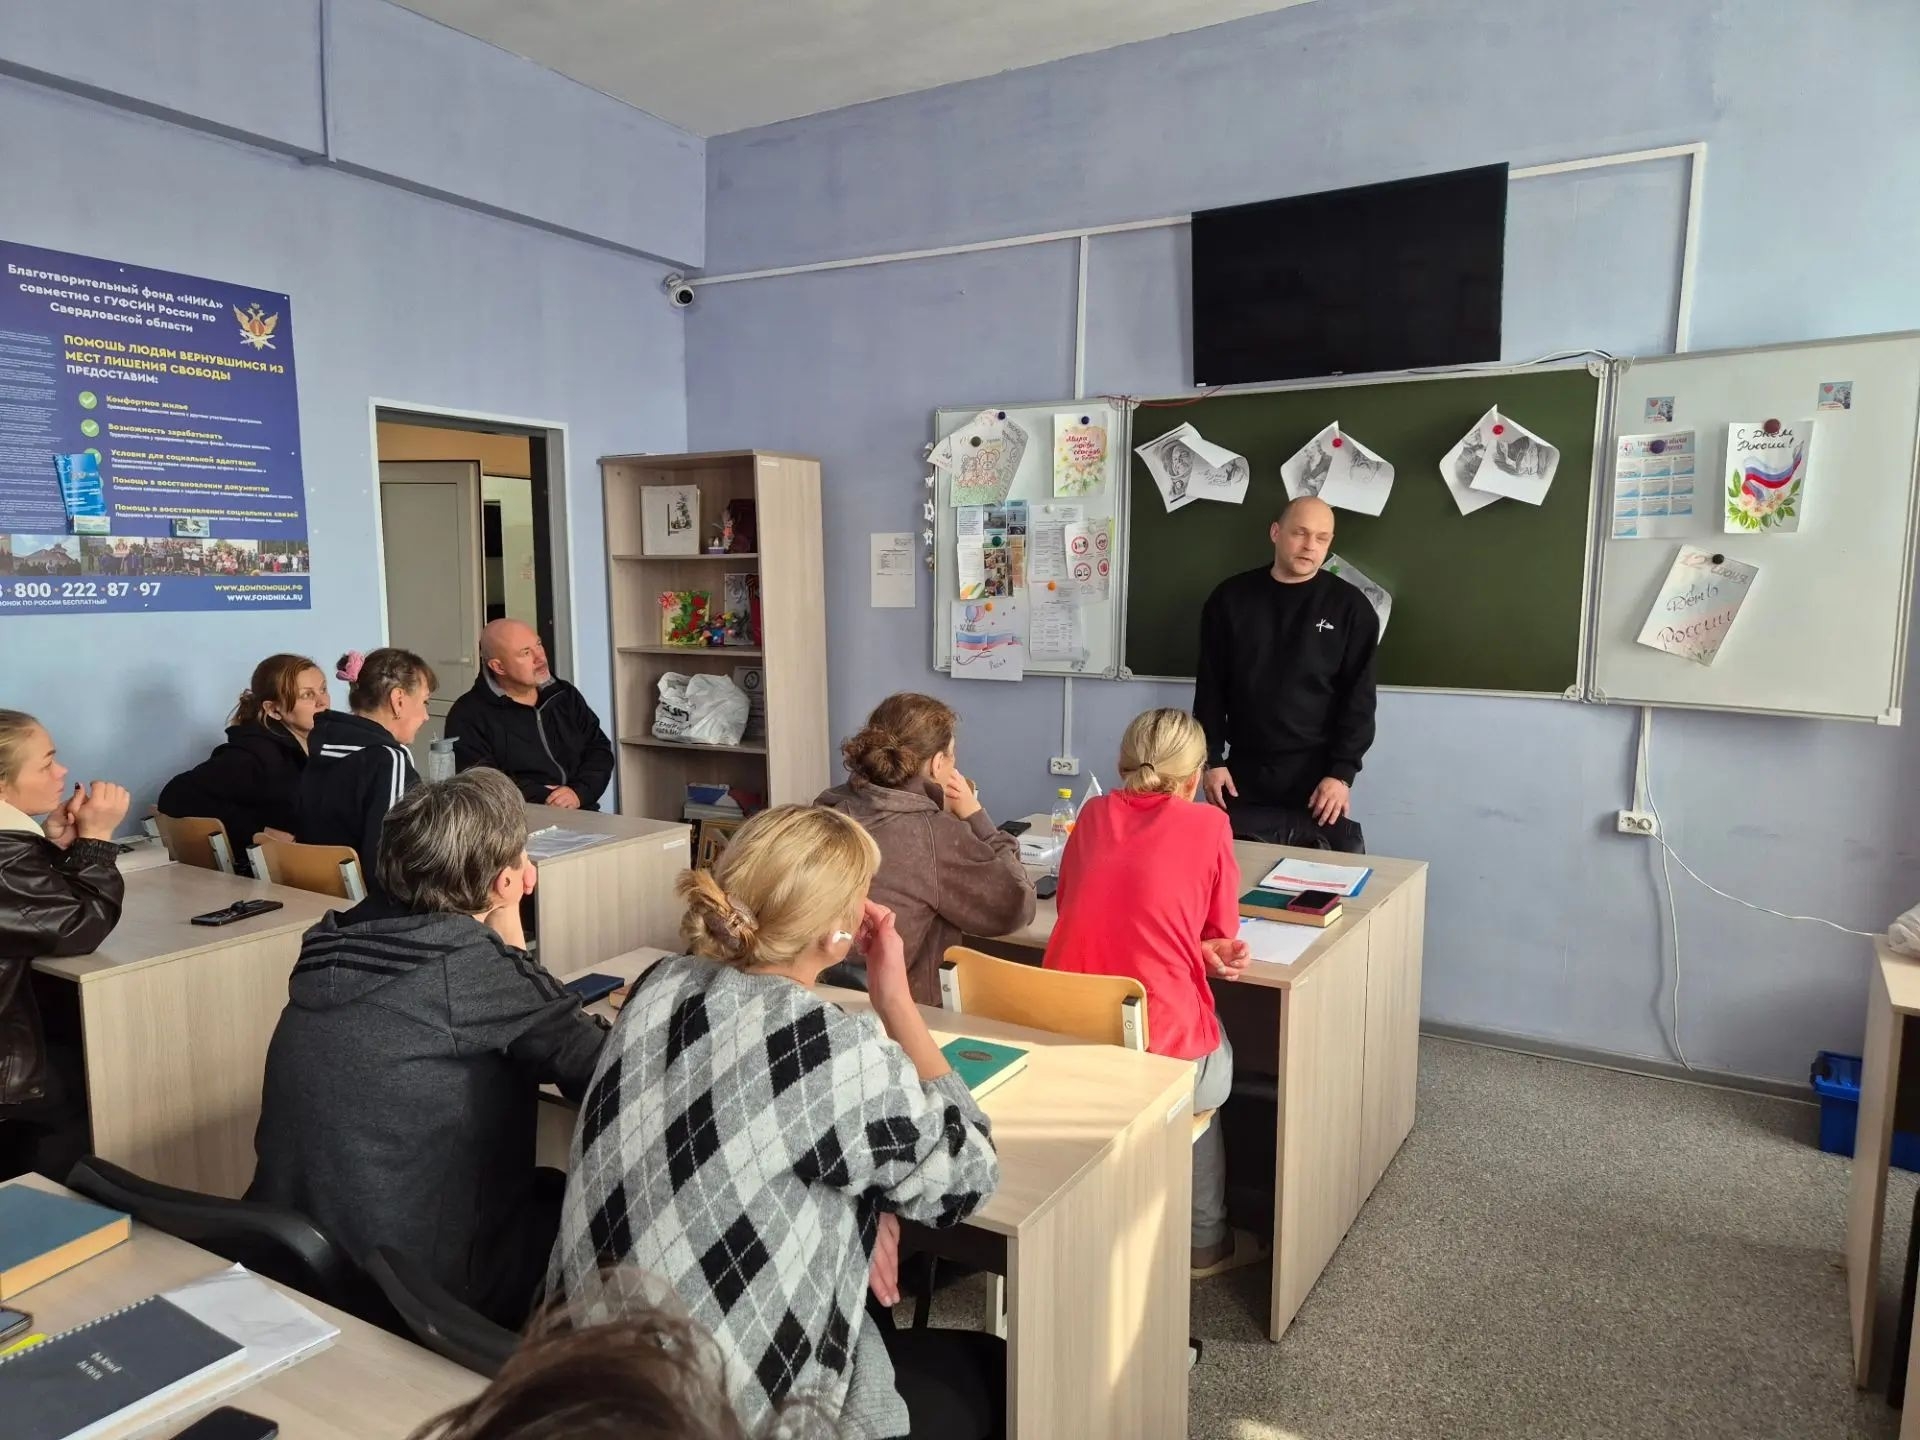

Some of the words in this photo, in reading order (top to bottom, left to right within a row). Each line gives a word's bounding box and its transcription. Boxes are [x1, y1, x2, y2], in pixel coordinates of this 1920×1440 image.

[8, 263, 139, 295] Благотворительный
[141, 287, 175, 303] фонд
[177, 294, 224, 309] «НИКА»
[19, 283, 90, 302] совместно
[93, 295, 101, 303] с
[104, 296, 156, 312] ГУФСИН
[158, 304, 199, 320] России
[202, 313, 216, 323] по
[50, 302, 143, 325] Свердловской
[145, 317, 194, 333] области
[65, 350, 101, 363] МЕСТ
[103, 355, 167, 373] ЛИШЕНИЯ
[170, 364, 231, 381] СВОБОДЫ
[128, 344, 177, 359] ЛЮДЯМ
[180, 351, 267, 372] ВЕРНУВШИМСЯ
[270, 364, 284, 374] ИЗ
[66, 364, 159, 384] ПРЕДОСТАВИМ:
[106, 395, 160, 408] Комфортное
[108, 423, 166, 436] Возможность
[167, 429, 223, 440] зарабатывать
[111, 449, 146, 458] Условия
[166, 454, 214, 464] социальной
[215, 458, 257, 467] адаптации
[112, 476, 148, 486] Помощь
[157, 480, 223, 490] восстановлении
[224, 484, 270, 493] документов
[114, 503, 151, 513] Помощь
[159, 507, 225, 515] восстановлении
[226, 509, 272, 517] социальных
[14, 582, 52, 598] 800
[61, 582, 98, 597] 222
[106, 582, 130, 597] 87
[139, 582, 161, 597] 97
[214, 584, 303, 592] WWW.ДОМПОМОЩИ.РФ
[62, 598, 107, 606] БЕСПЛАТНЫЙ
[1657, 610, 1731, 650] России
